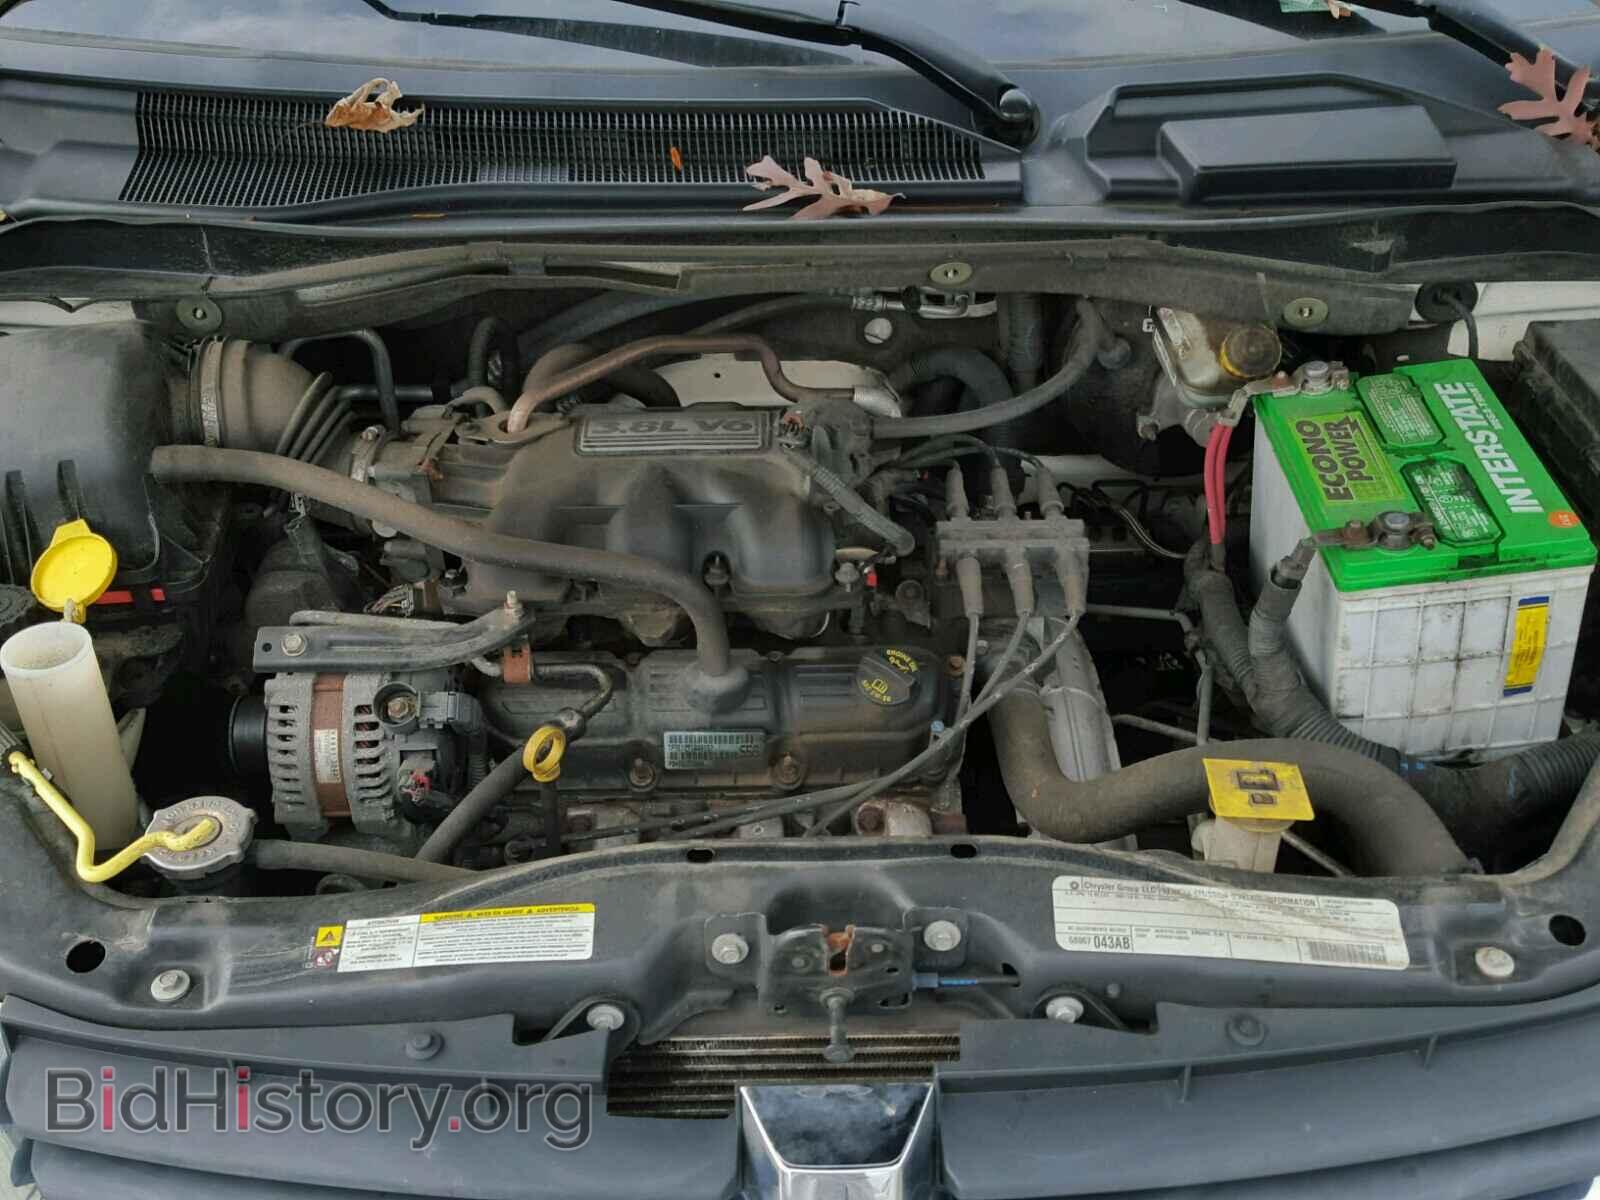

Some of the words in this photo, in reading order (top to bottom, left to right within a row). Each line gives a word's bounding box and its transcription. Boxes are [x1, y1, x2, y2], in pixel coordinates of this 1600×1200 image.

[695, 418, 753, 432] V6
[1295, 420, 1354, 500] ECONO
[1324, 416, 1375, 481] POWER
[1434, 381, 1544, 514] INTERSTATE
[1083, 880, 1115, 892] Chrysler
[1093, 935, 1131, 950] 043AB
